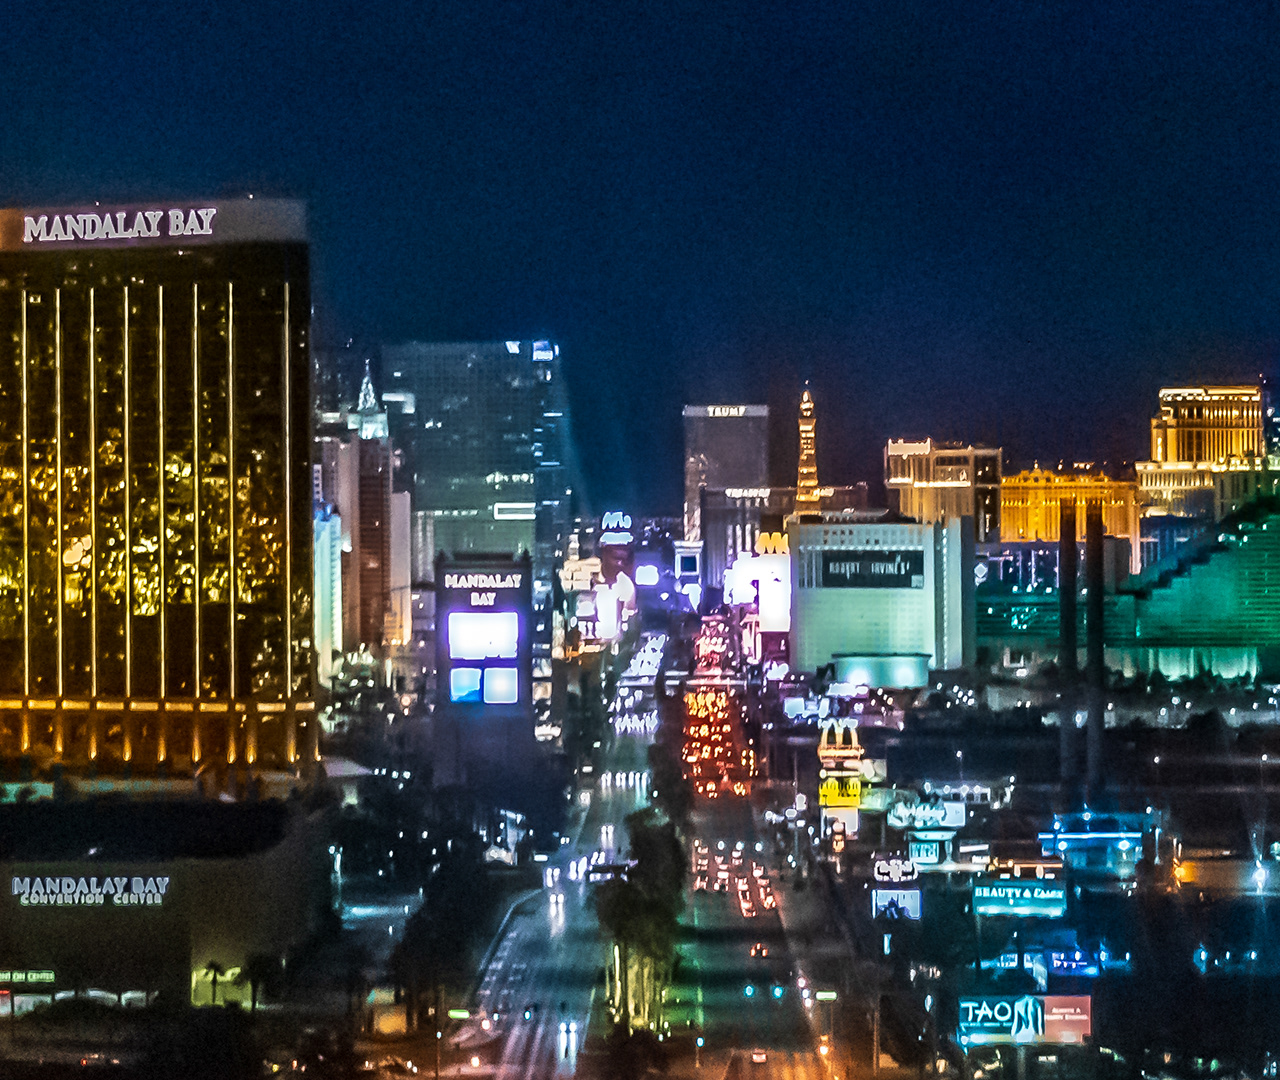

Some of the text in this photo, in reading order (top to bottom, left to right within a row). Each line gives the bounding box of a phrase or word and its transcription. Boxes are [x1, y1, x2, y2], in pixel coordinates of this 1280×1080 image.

[23, 208, 217, 242] MANDALAY BAY
[444, 574, 522, 588] MANDALAY
[470, 592, 496, 606] BAY
[12, 876, 169, 895] MANDALAY BAY
[974, 887, 1021, 898] BEAUTY
[20, 893, 162, 906] CONVENTION CENTER
[960, 1001, 1012, 1022] TAO
